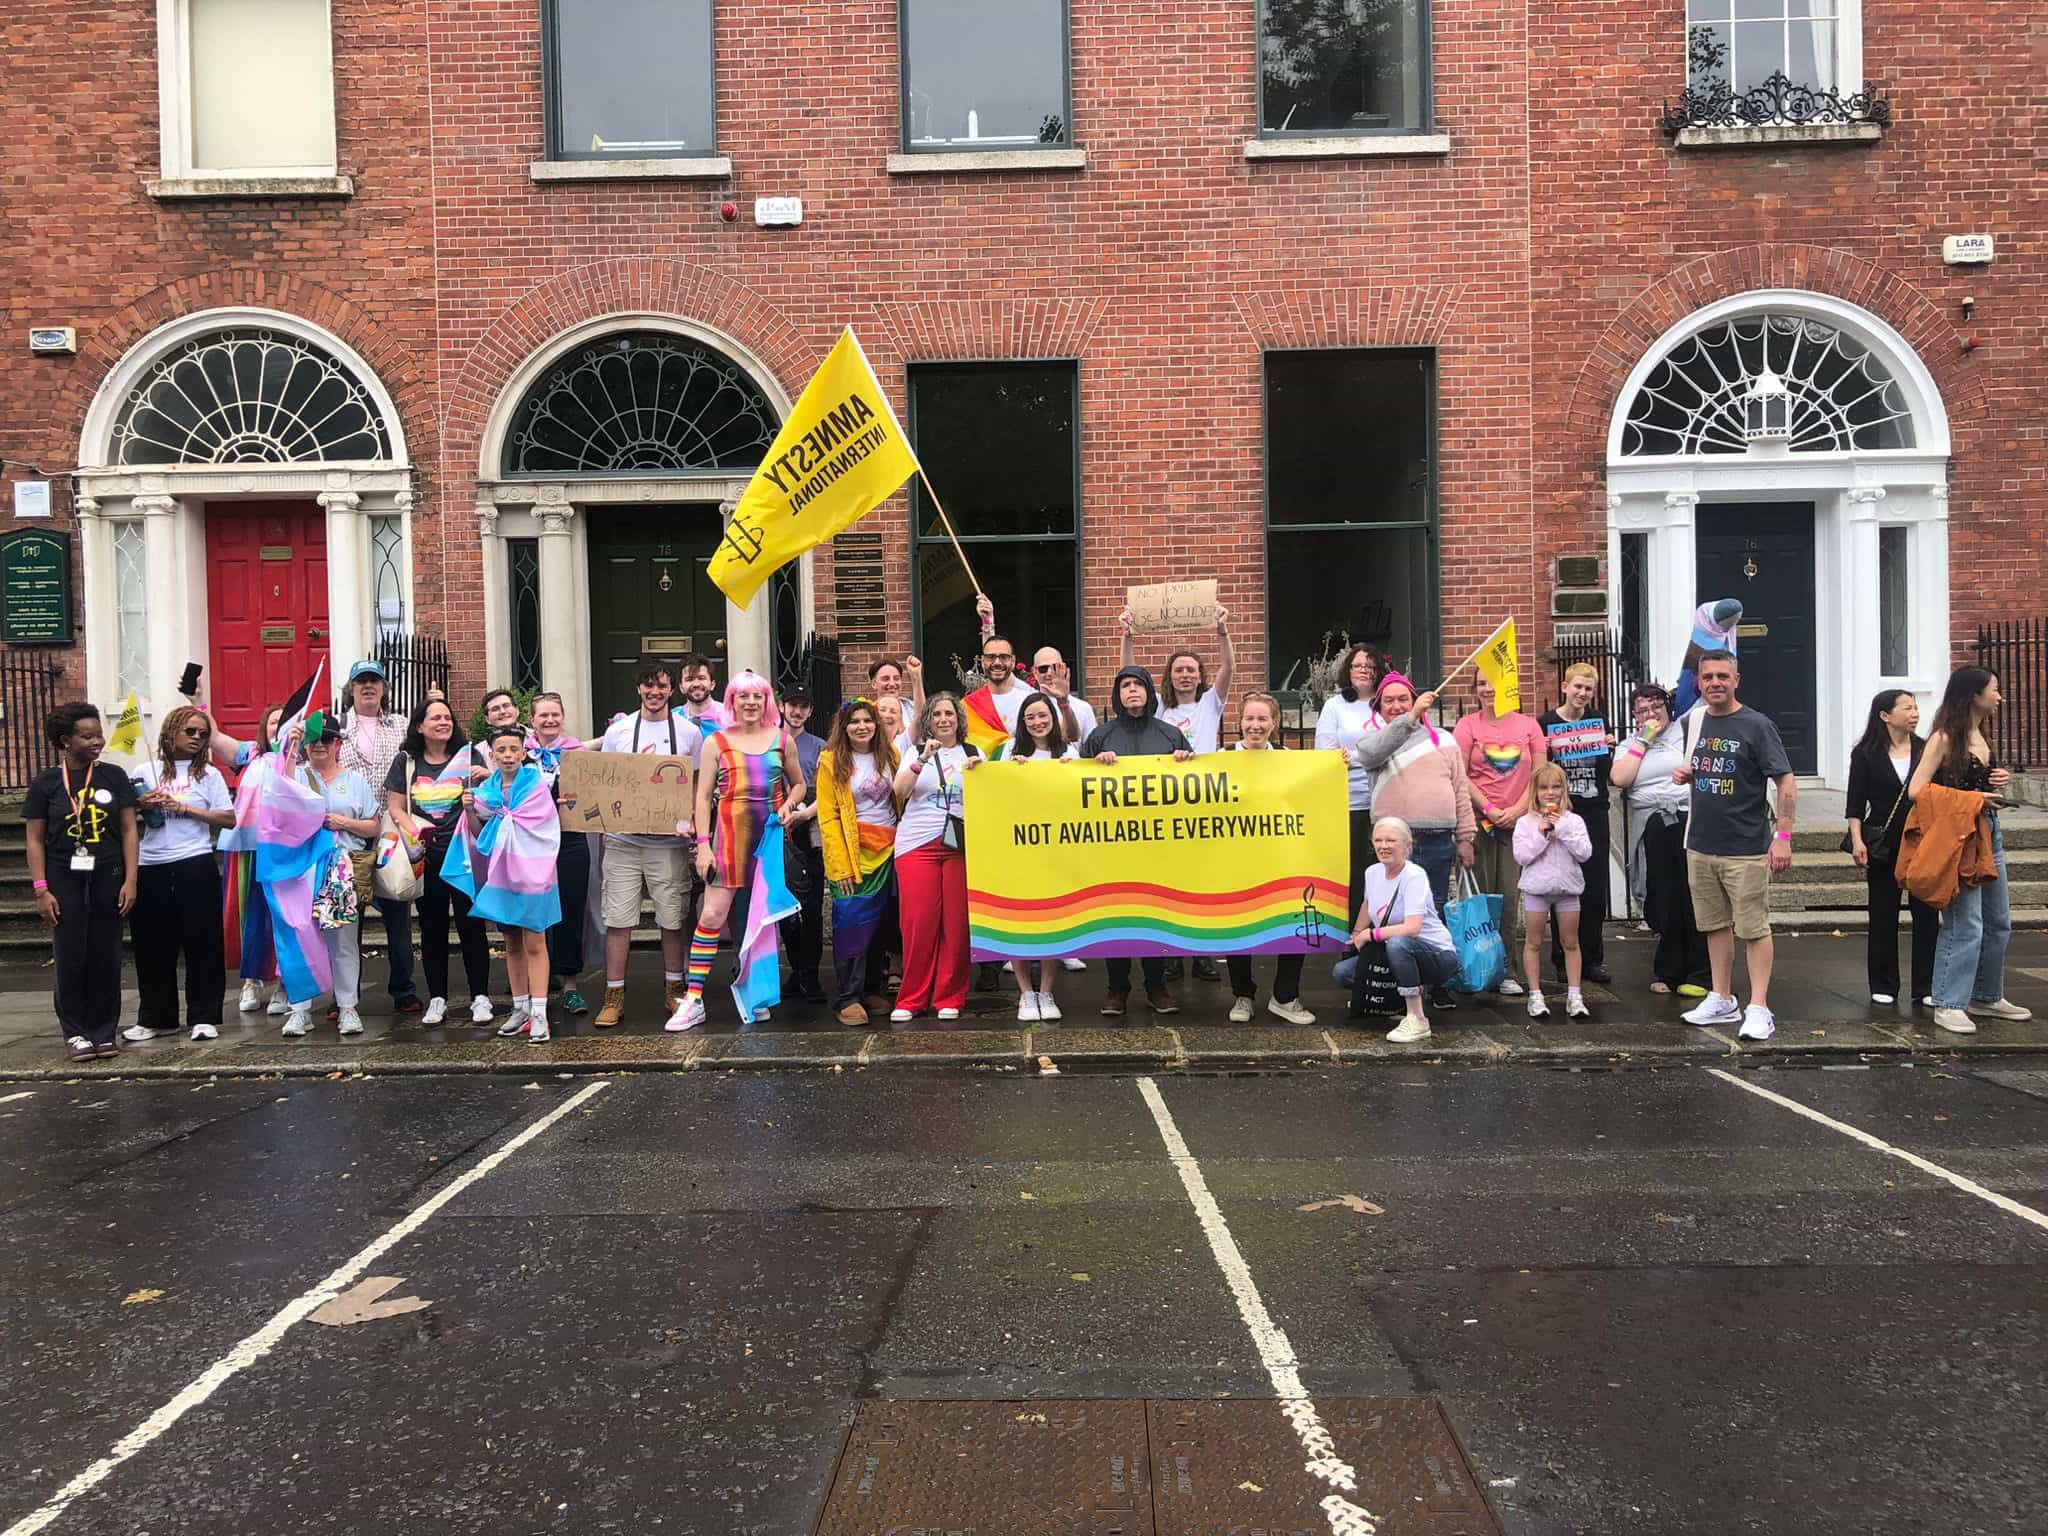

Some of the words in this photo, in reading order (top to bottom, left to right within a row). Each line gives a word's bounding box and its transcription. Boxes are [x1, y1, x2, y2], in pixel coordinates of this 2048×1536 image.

[1956, 239, 1986, 248] LARA
[1554, 724, 1573, 735] GOD
[1576, 720, 1601, 731] LOVES
[1557, 741, 1601, 757] TRANNIES
[1692, 755, 1736, 773] RANS
[1081, 771, 1240, 809] FREEDOM:
[1014, 823, 1051, 846] NOT
[1059, 818, 1165, 844] AVAILABLE
[1173, 814, 1306, 840] EVERYWHERE
